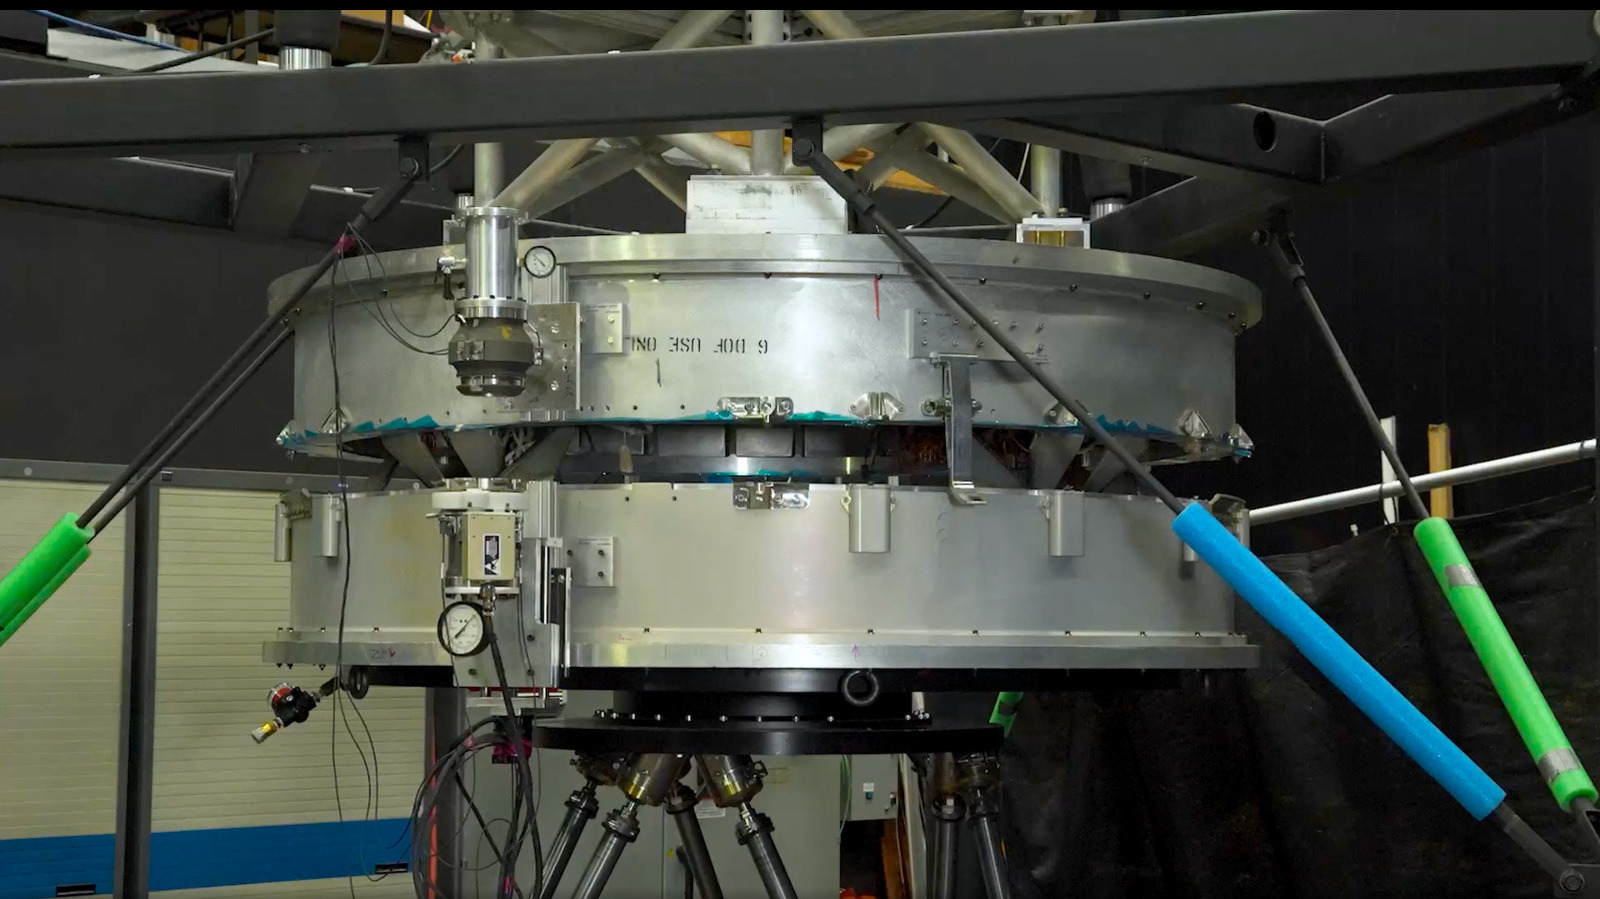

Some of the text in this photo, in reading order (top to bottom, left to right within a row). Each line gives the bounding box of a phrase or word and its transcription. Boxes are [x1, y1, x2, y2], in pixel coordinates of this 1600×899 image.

[624, 336, 768, 354] 6 DOF USE ONL
